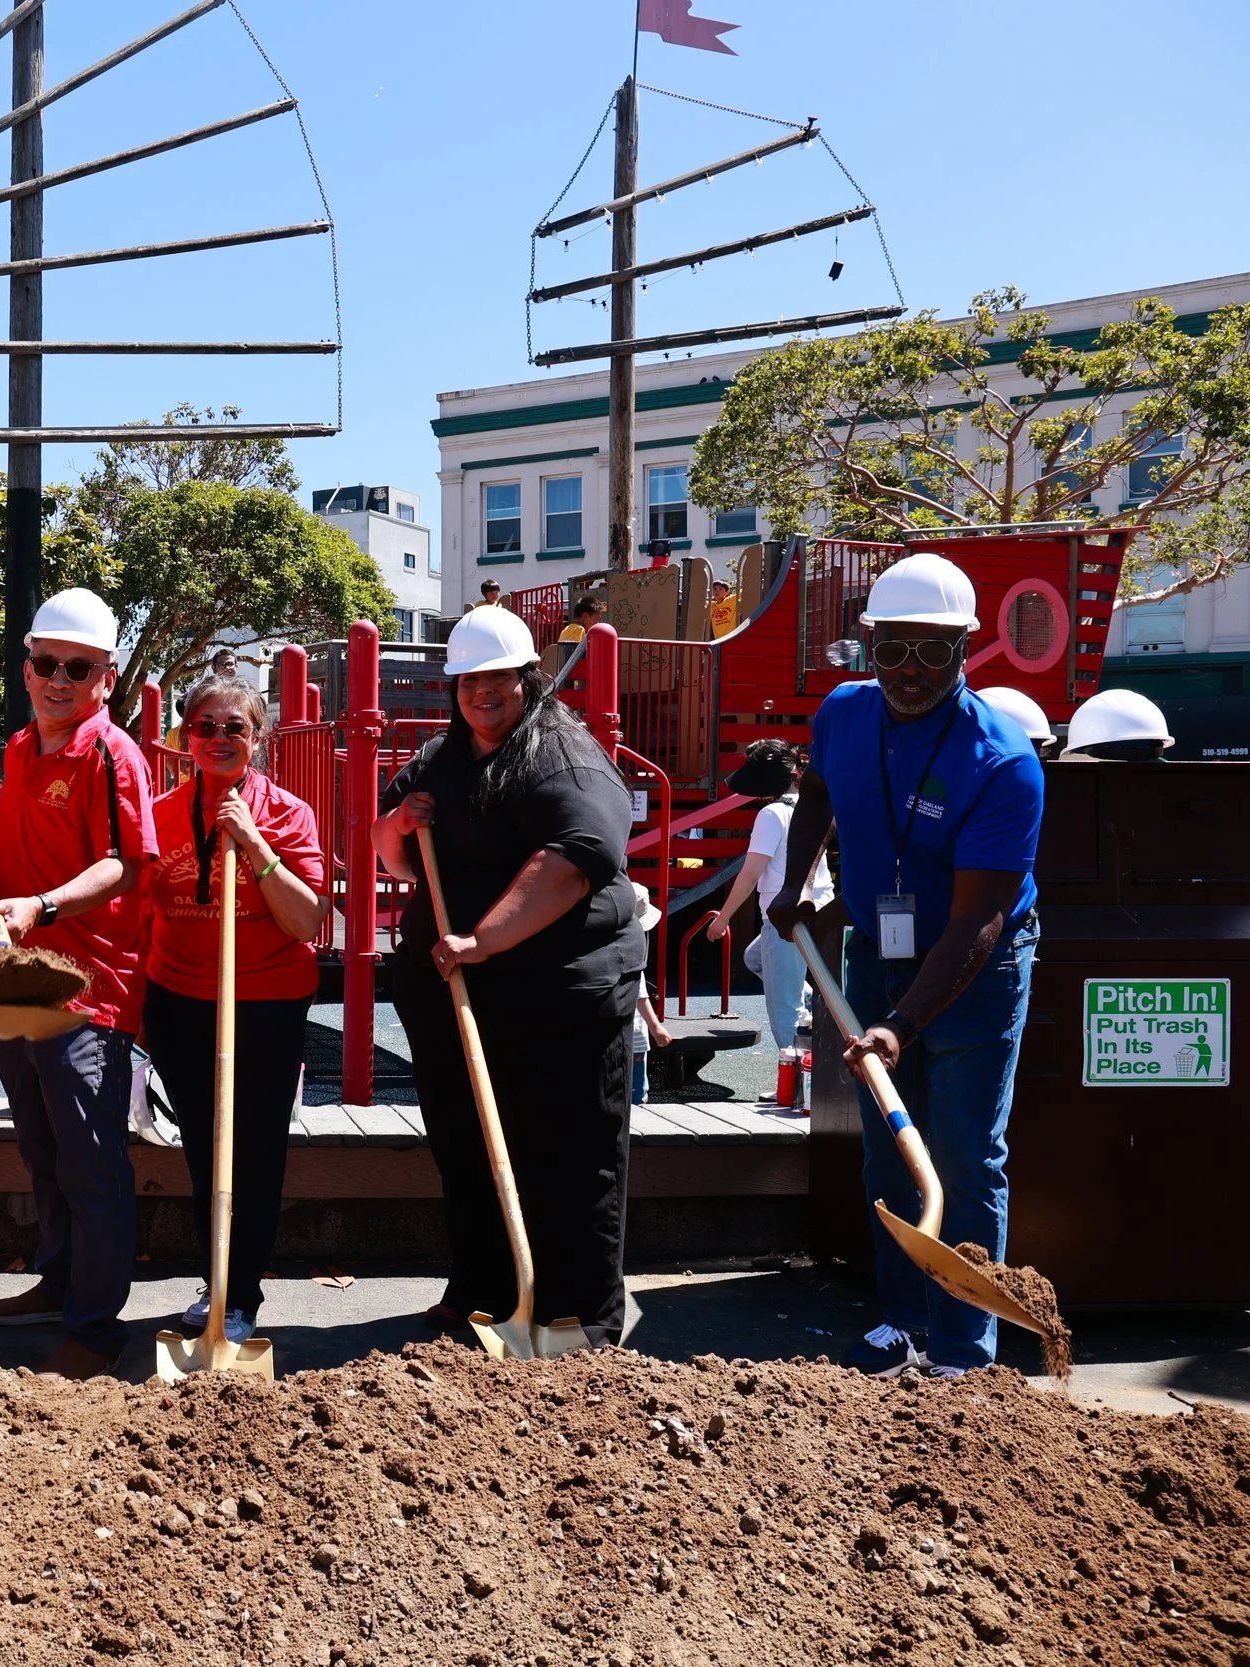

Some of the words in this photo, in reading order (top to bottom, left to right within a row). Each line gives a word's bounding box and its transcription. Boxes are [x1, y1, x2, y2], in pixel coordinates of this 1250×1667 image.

[1097, 986, 1172, 1012] Pitch
[1183, 986, 1218, 1012] In!
[1097, 1018, 1137, 1034] Put
[1143, 1017, 1208, 1034] Trash
[1097, 1038, 1118, 1054] In
[1125, 1038, 1153, 1054] Its
[1096, 1058, 1162, 1074] Place
